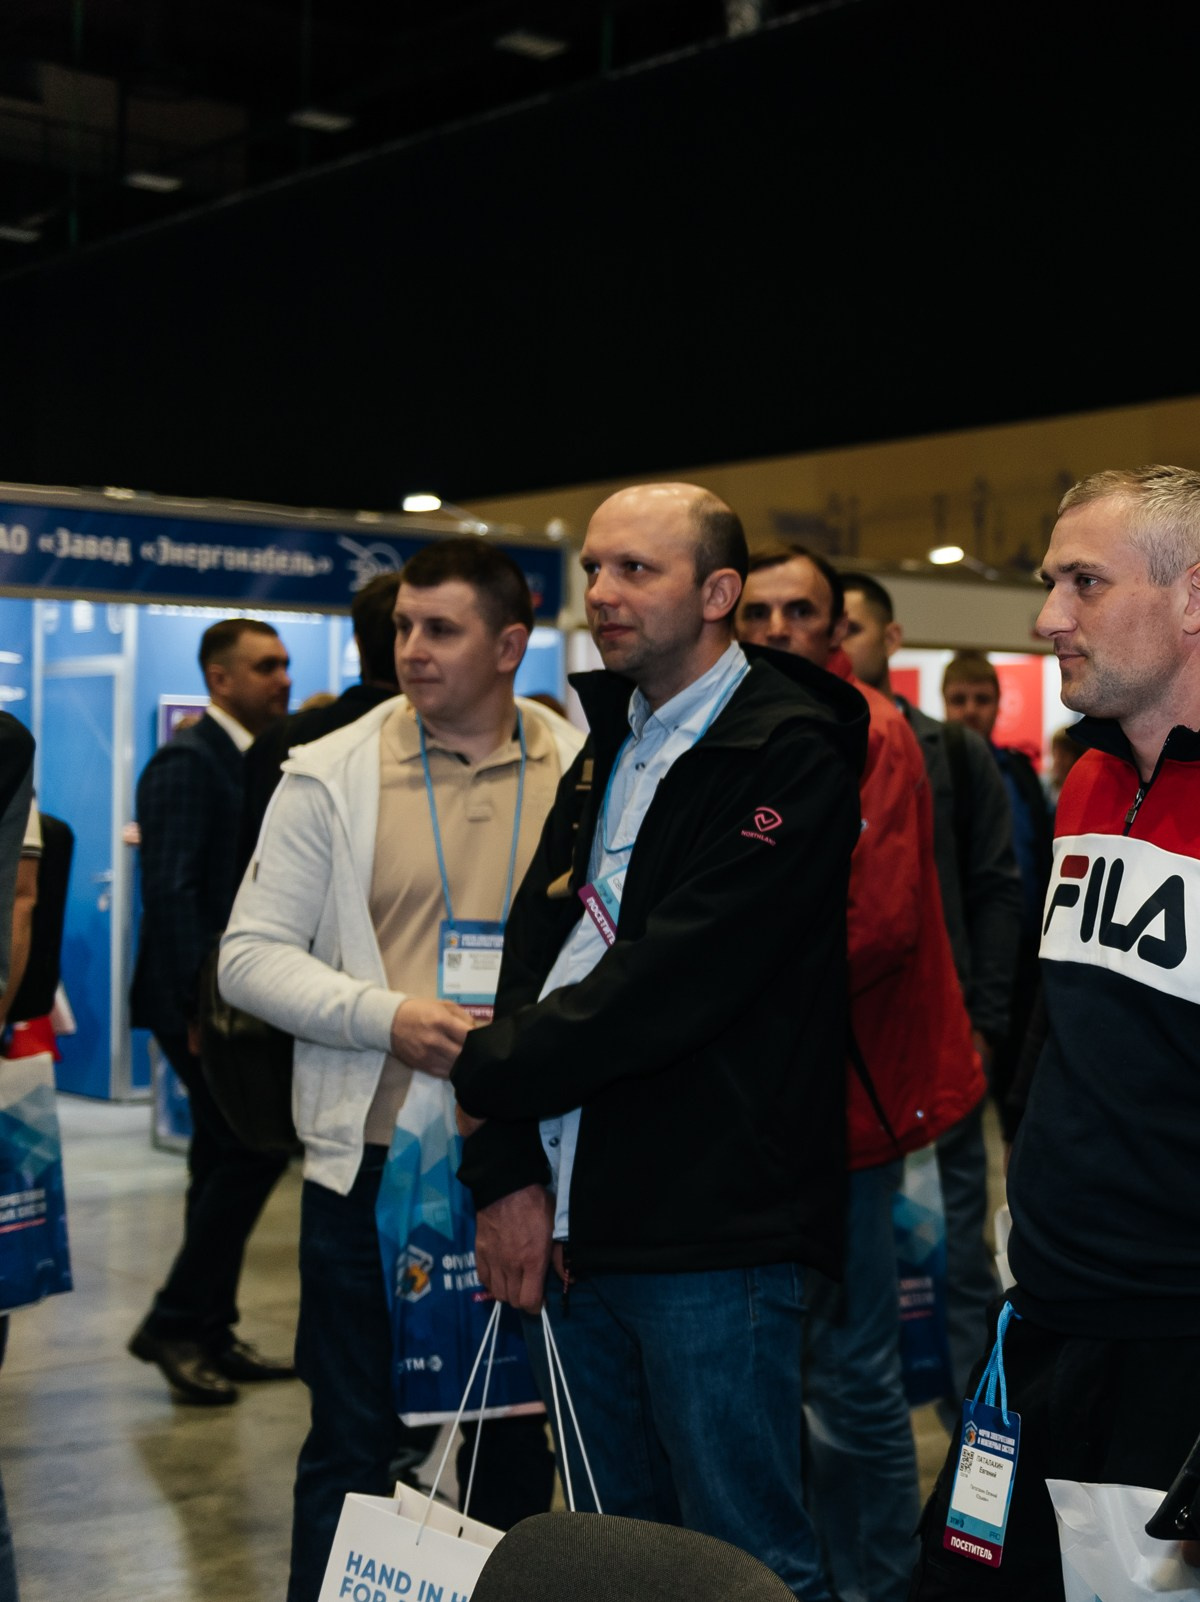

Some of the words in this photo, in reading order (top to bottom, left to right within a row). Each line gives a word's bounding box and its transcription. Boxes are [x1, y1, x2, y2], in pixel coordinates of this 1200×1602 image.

[587, 897, 616, 945] ПОСЕТИТЕ
[1043, 855, 1187, 970] FILA
[950, 1535, 993, 1560] ПОСЕТИТЕЛЬ
[345, 1550, 412, 1595] HAND
[417, 1579, 445, 1602] IN
